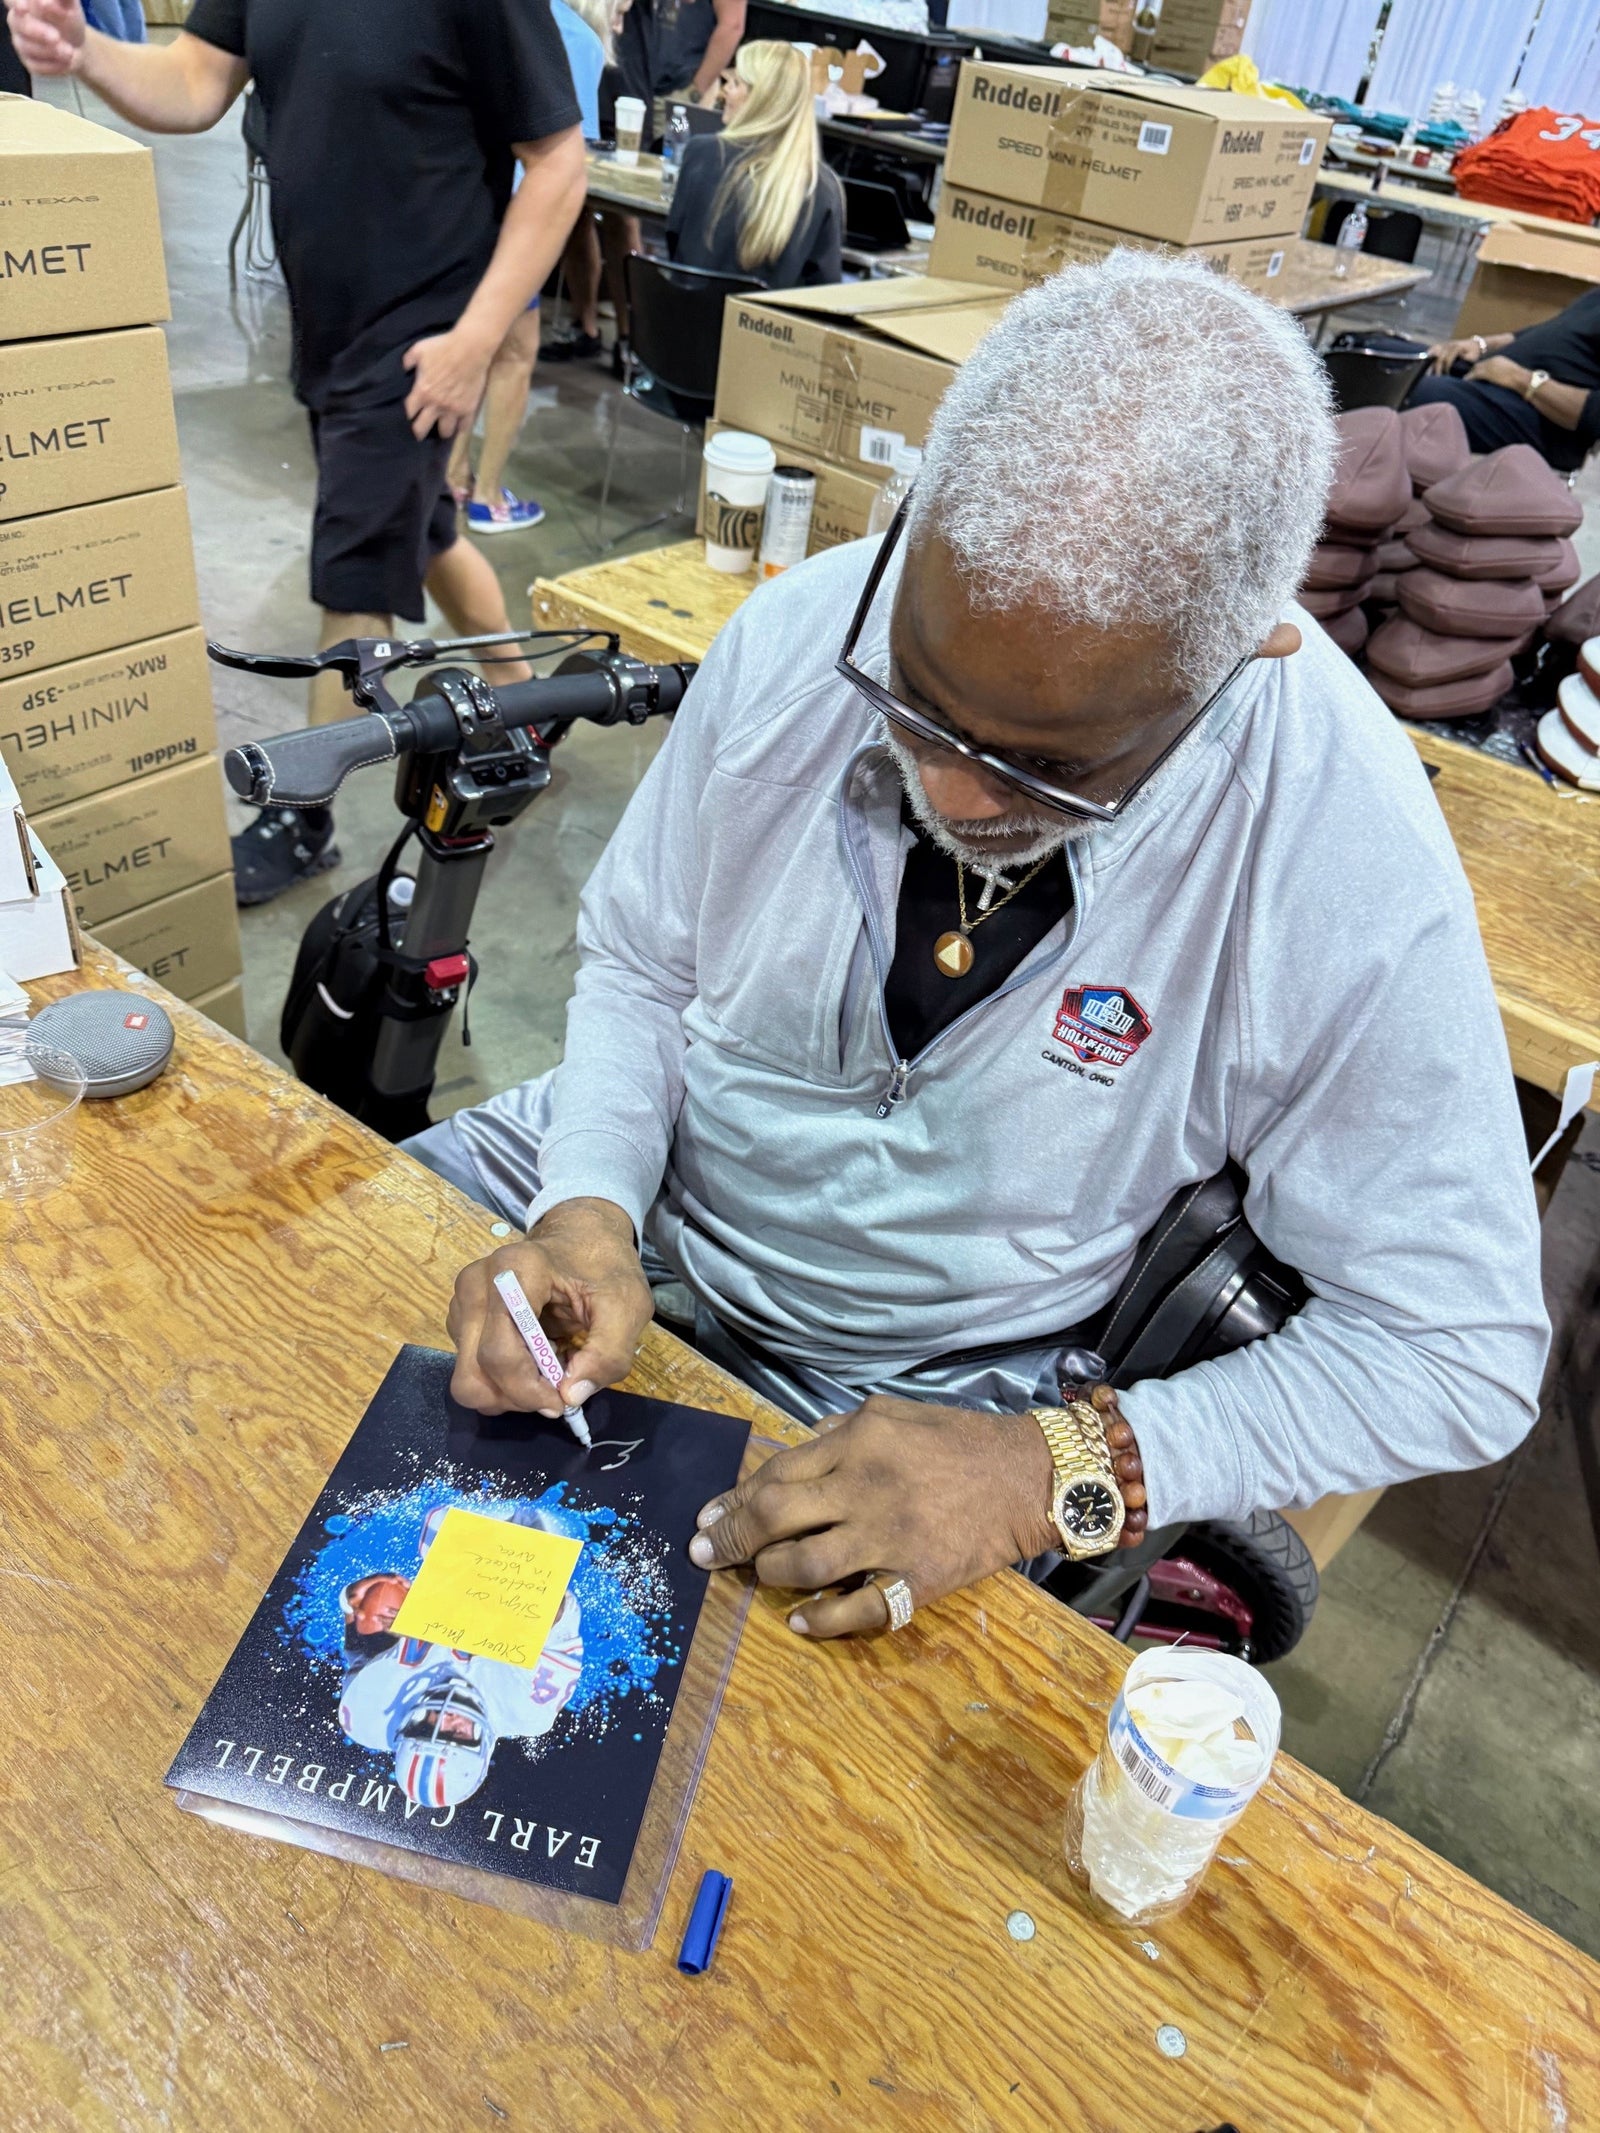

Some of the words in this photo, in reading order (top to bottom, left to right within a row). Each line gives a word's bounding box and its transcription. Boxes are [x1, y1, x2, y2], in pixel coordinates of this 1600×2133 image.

[972, 76, 1061, 118] Riddell
[998, 137, 1043, 158] SPEED
[1047, 150, 1076, 168] MINI
[1080, 157, 1142, 182] HELMET
[1220, 130, 1264, 154] Riddell
[21, 195, 100, 206] TEXAS
[952, 199, 1035, 240] Riddell
[0, 243, 92, 278] MET
[976, 255, 1018, 276] SPEED
[737, 311, 795, 343] Riddell
[780, 370, 818, 397] MINI
[818, 383, 898, 422] HELMET
[0, 417, 111, 461] LMET
[82, 691, 149, 731] MINI
[0, 714, 76, 752] HEL
[130, 737, 197, 773] Riddell
[66, 837, 172, 894] ELMET
[1057, 1024, 1089, 1049] HALL
[1094, 1042, 1130, 1063] FAME
[1089, 1072, 1115, 1087] OHIO
[530, 1333, 563, 1391] coColor
[499, 1594, 541, 1619] Sign
[472, 1638, 526, 1665] Silver
[214, 1739, 456, 1829] CAMPBELL
[482, 1809, 602, 1869] EARL
